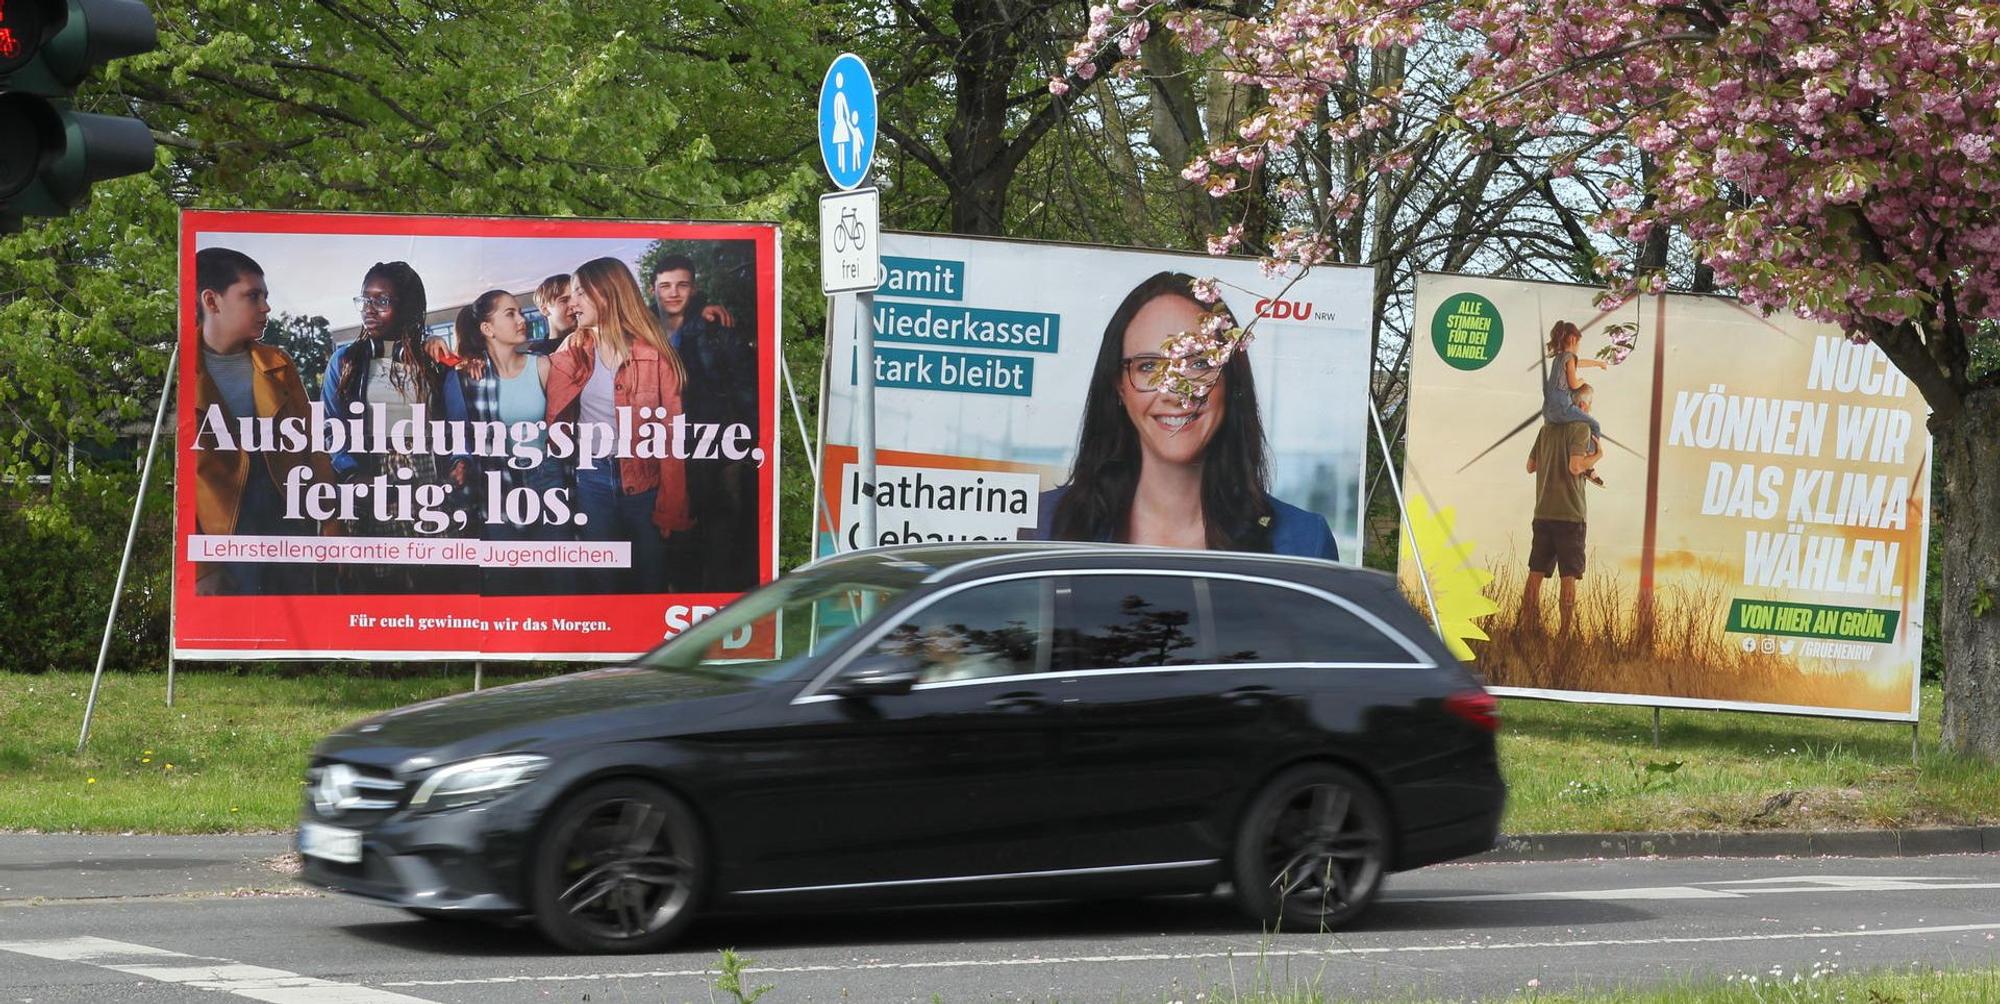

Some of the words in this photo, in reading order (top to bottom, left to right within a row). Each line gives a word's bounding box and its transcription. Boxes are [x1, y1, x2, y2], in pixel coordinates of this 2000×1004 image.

[842, 258, 860, 279] frei
[1255, 299, 1312, 320] CDU
[1314, 312, 1336, 321] NRW
[1446, 314, 1492, 331] STIMMEN
[1457, 301, 1482, 315] ALLE
[873, 307, 1050, 346] Niederkassel
[1448, 328, 1468, 344] FÜR
[1468, 331, 1489, 345] DEN
[1446, 344, 1488, 360] WANDEL.
[874, 353, 934, 384] tark
[940, 355, 1024, 390] bleibt
[190, 402, 766, 470] Ausbildungsplätze,
[1668, 383, 1829, 458] KÖNNEN
[1836, 405, 1912, 464] WIR
[283, 465, 468, 535] fertig,
[484, 471, 589, 527] los.
[1701, 461, 1786, 519] DAS
[1787, 468, 1909, 531] KLIMA
[203, 540, 400, 562] Lehrstellengarantie
[407, 542, 435, 560] für
[442, 542, 477, 560] alle
[483, 545, 619, 567] Jugendlichen.
[1743, 521, 1902, 597] WÄHLEN.
[350, 614, 376, 628] Für
[380, 615, 414, 628] euch
[418, 615, 489, 630] gewinnen
[493, 618, 519, 631] wir
[522, 618, 548, 631] das
[552, 618, 612, 633] Morgen.
[1740, 604, 1774, 630] VON
[1774, 607, 1813, 633] HIER
[1812, 610, 1839, 635] AN
[1839, 609, 1886, 638] GRÜN.
